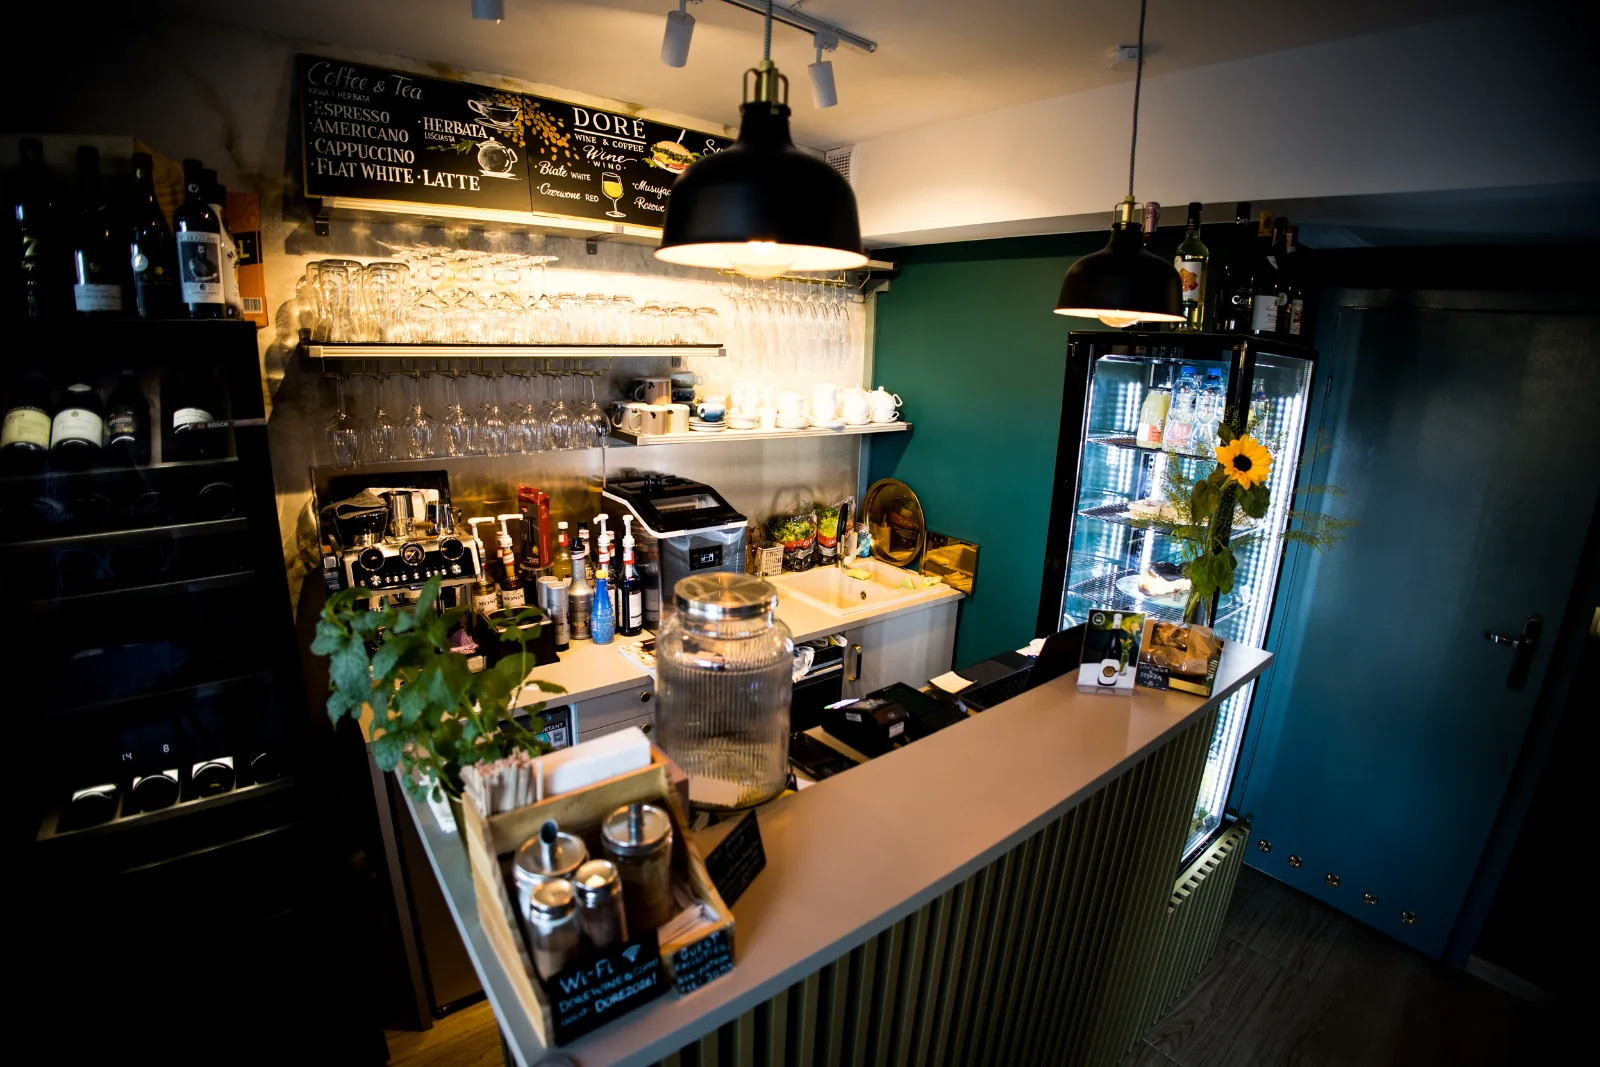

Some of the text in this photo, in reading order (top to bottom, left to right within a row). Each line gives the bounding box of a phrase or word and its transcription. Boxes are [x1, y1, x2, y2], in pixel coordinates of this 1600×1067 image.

[308, 61, 423, 100] Coffee & Tea
[308, 87, 329, 97] KAWA
[337, 91, 371, 103] HERBATA
[314, 100, 390, 124] ESPRESSO
[313, 118, 409, 143] AMERICANO
[423, 116, 489, 139] HERBATA
[572, 107, 646, 139] DORÉ
[314, 138, 415, 164] CAPPUCCINO
[574, 133, 597, 144] WINE
[612, 141, 644, 153] COFFEE
[583, 145, 637, 163] Wine
[316, 158, 414, 184] FLAT WHITE
[570, 171, 591, 181] WHITE
[592, 160, 622, 171] WINO
[423, 169, 481, 191] LATTE
[585, 193, 600, 203] RED
[121, 751, 133, 761] 14
[162, 743, 170, 753] 8
